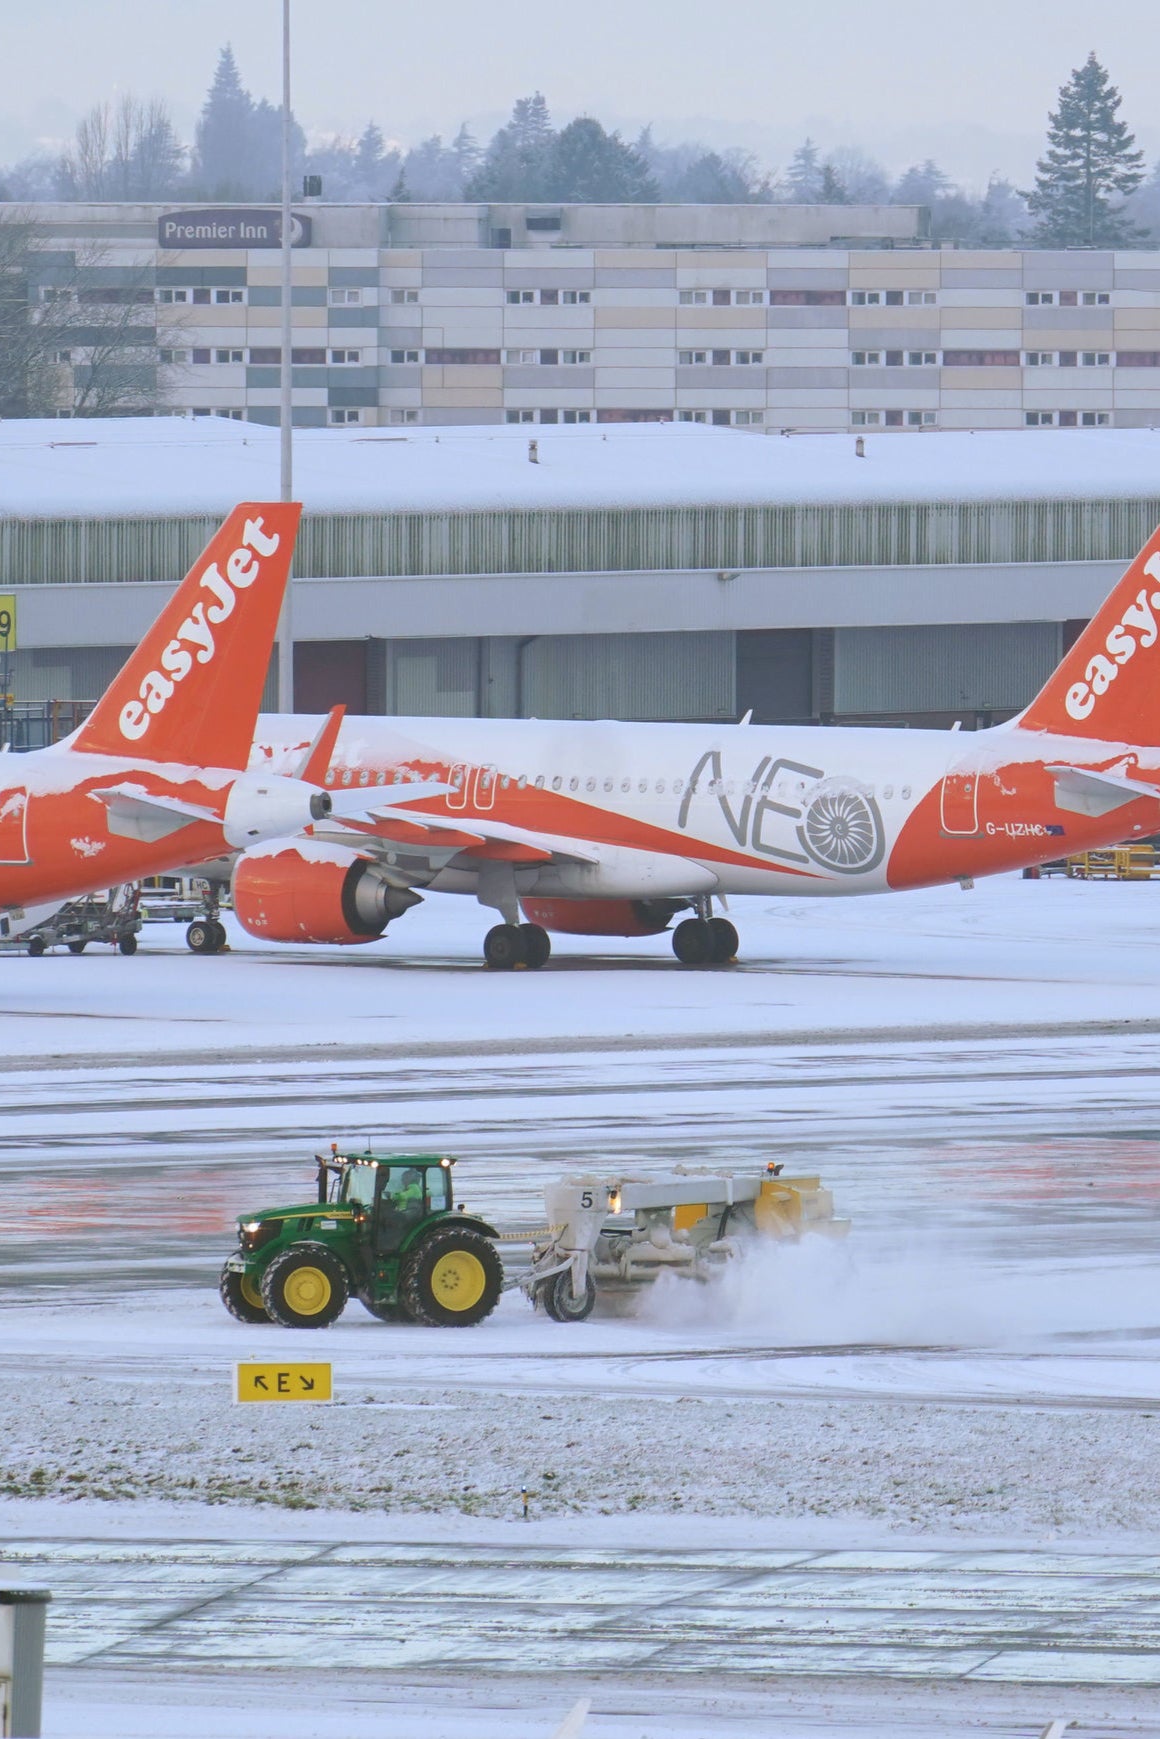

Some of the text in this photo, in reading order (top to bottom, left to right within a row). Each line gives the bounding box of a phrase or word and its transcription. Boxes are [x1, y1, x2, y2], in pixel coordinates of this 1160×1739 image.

[165, 221, 267, 239] Premier Inn
[119, 516, 280, 741] easyJet
[581, 1191, 593, 1208] 5
[277, 1372, 290, 1393] E
